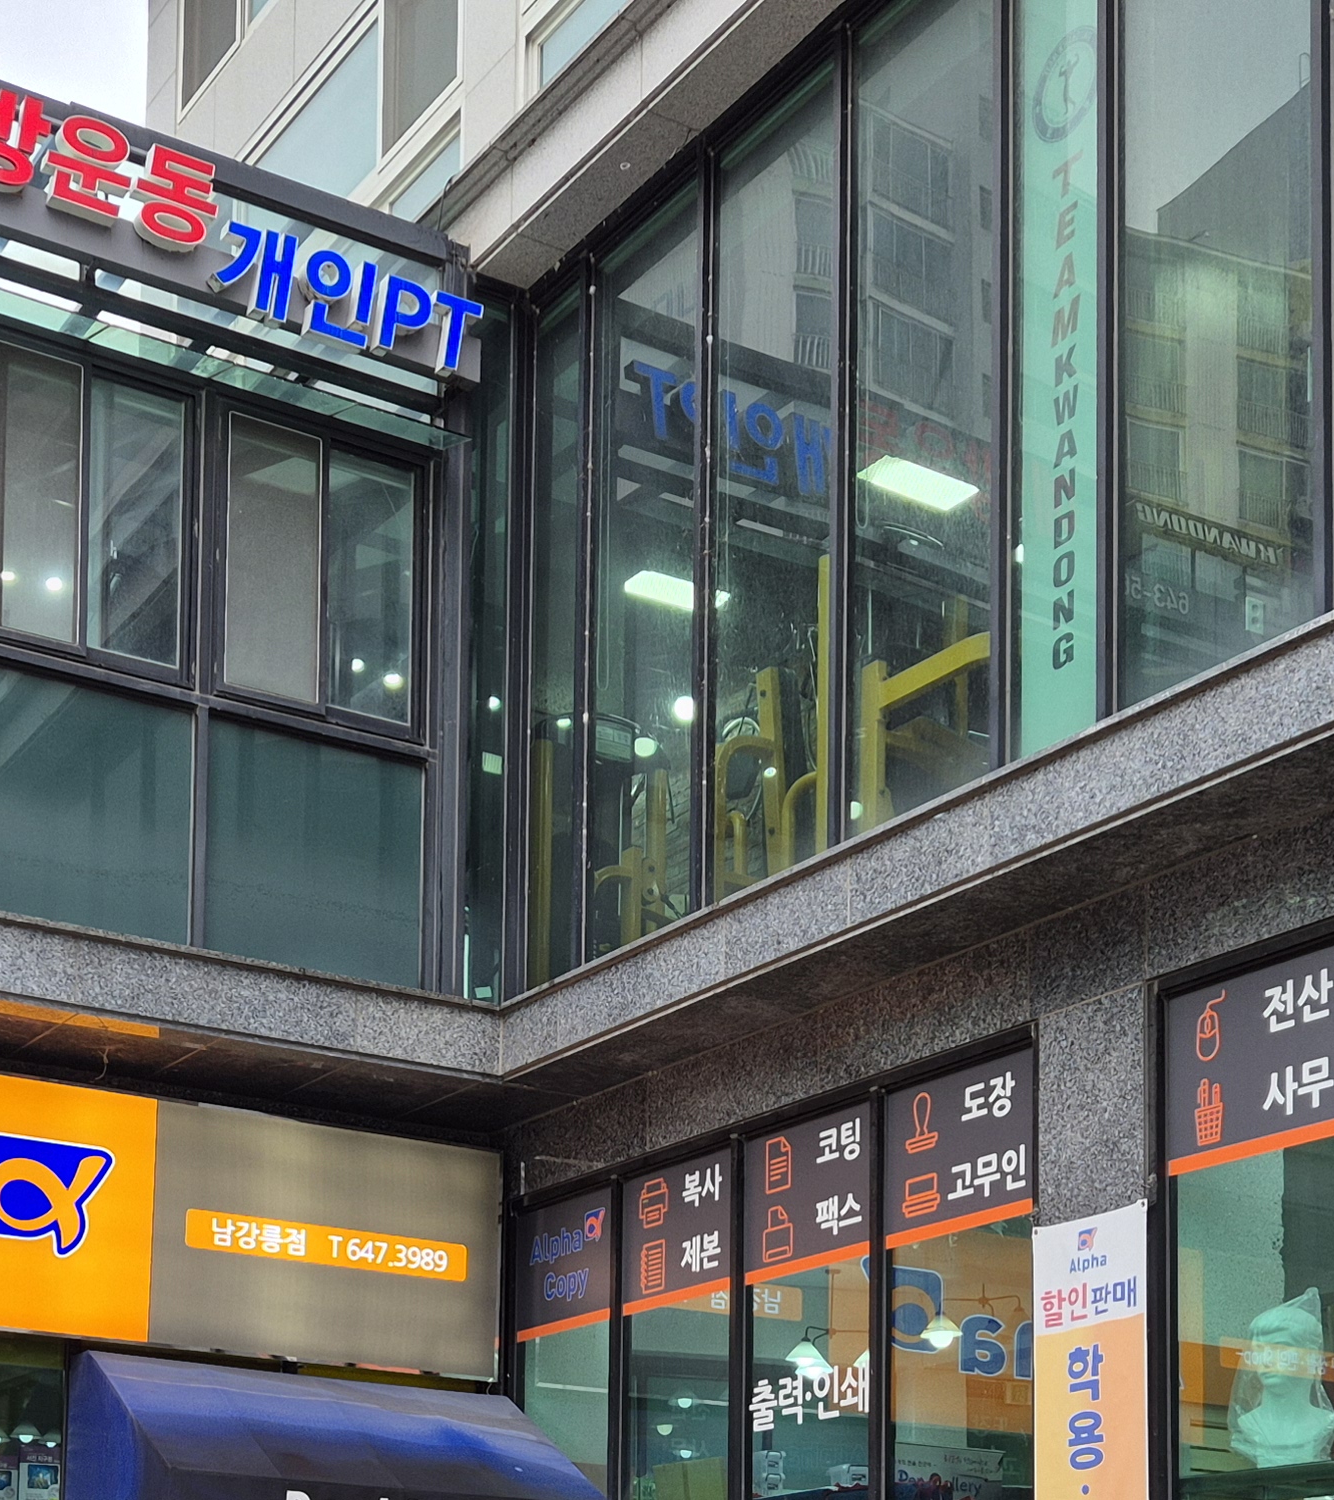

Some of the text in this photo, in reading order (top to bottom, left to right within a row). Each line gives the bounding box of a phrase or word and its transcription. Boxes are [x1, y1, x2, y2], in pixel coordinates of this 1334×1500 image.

[207, 220, 484, 375] 개인PT
[1262, 968, 1334, 1034] 전산
[960, 1072, 1016, 1122] 도장
[1262, 1055, 1334, 1116] 사무
[815, 1117, 862, 1164] 코팅
[681, 1164, 723, 1208] 복사
[946, 1144, 1027, 1201] 고무인
[815, 1193, 863, 1236] 팩스
[210, 1217, 450, 1275] 남강릉점 T 647.3989
[530, 1224, 584, 1266] Alpha
[680, 1230, 722, 1273] 제본
[1069, 1254, 1107, 1274] Alpha
[543, 1267, 590, 1301] Copy
[1041, 1276, 1138, 1328] 할인판매
